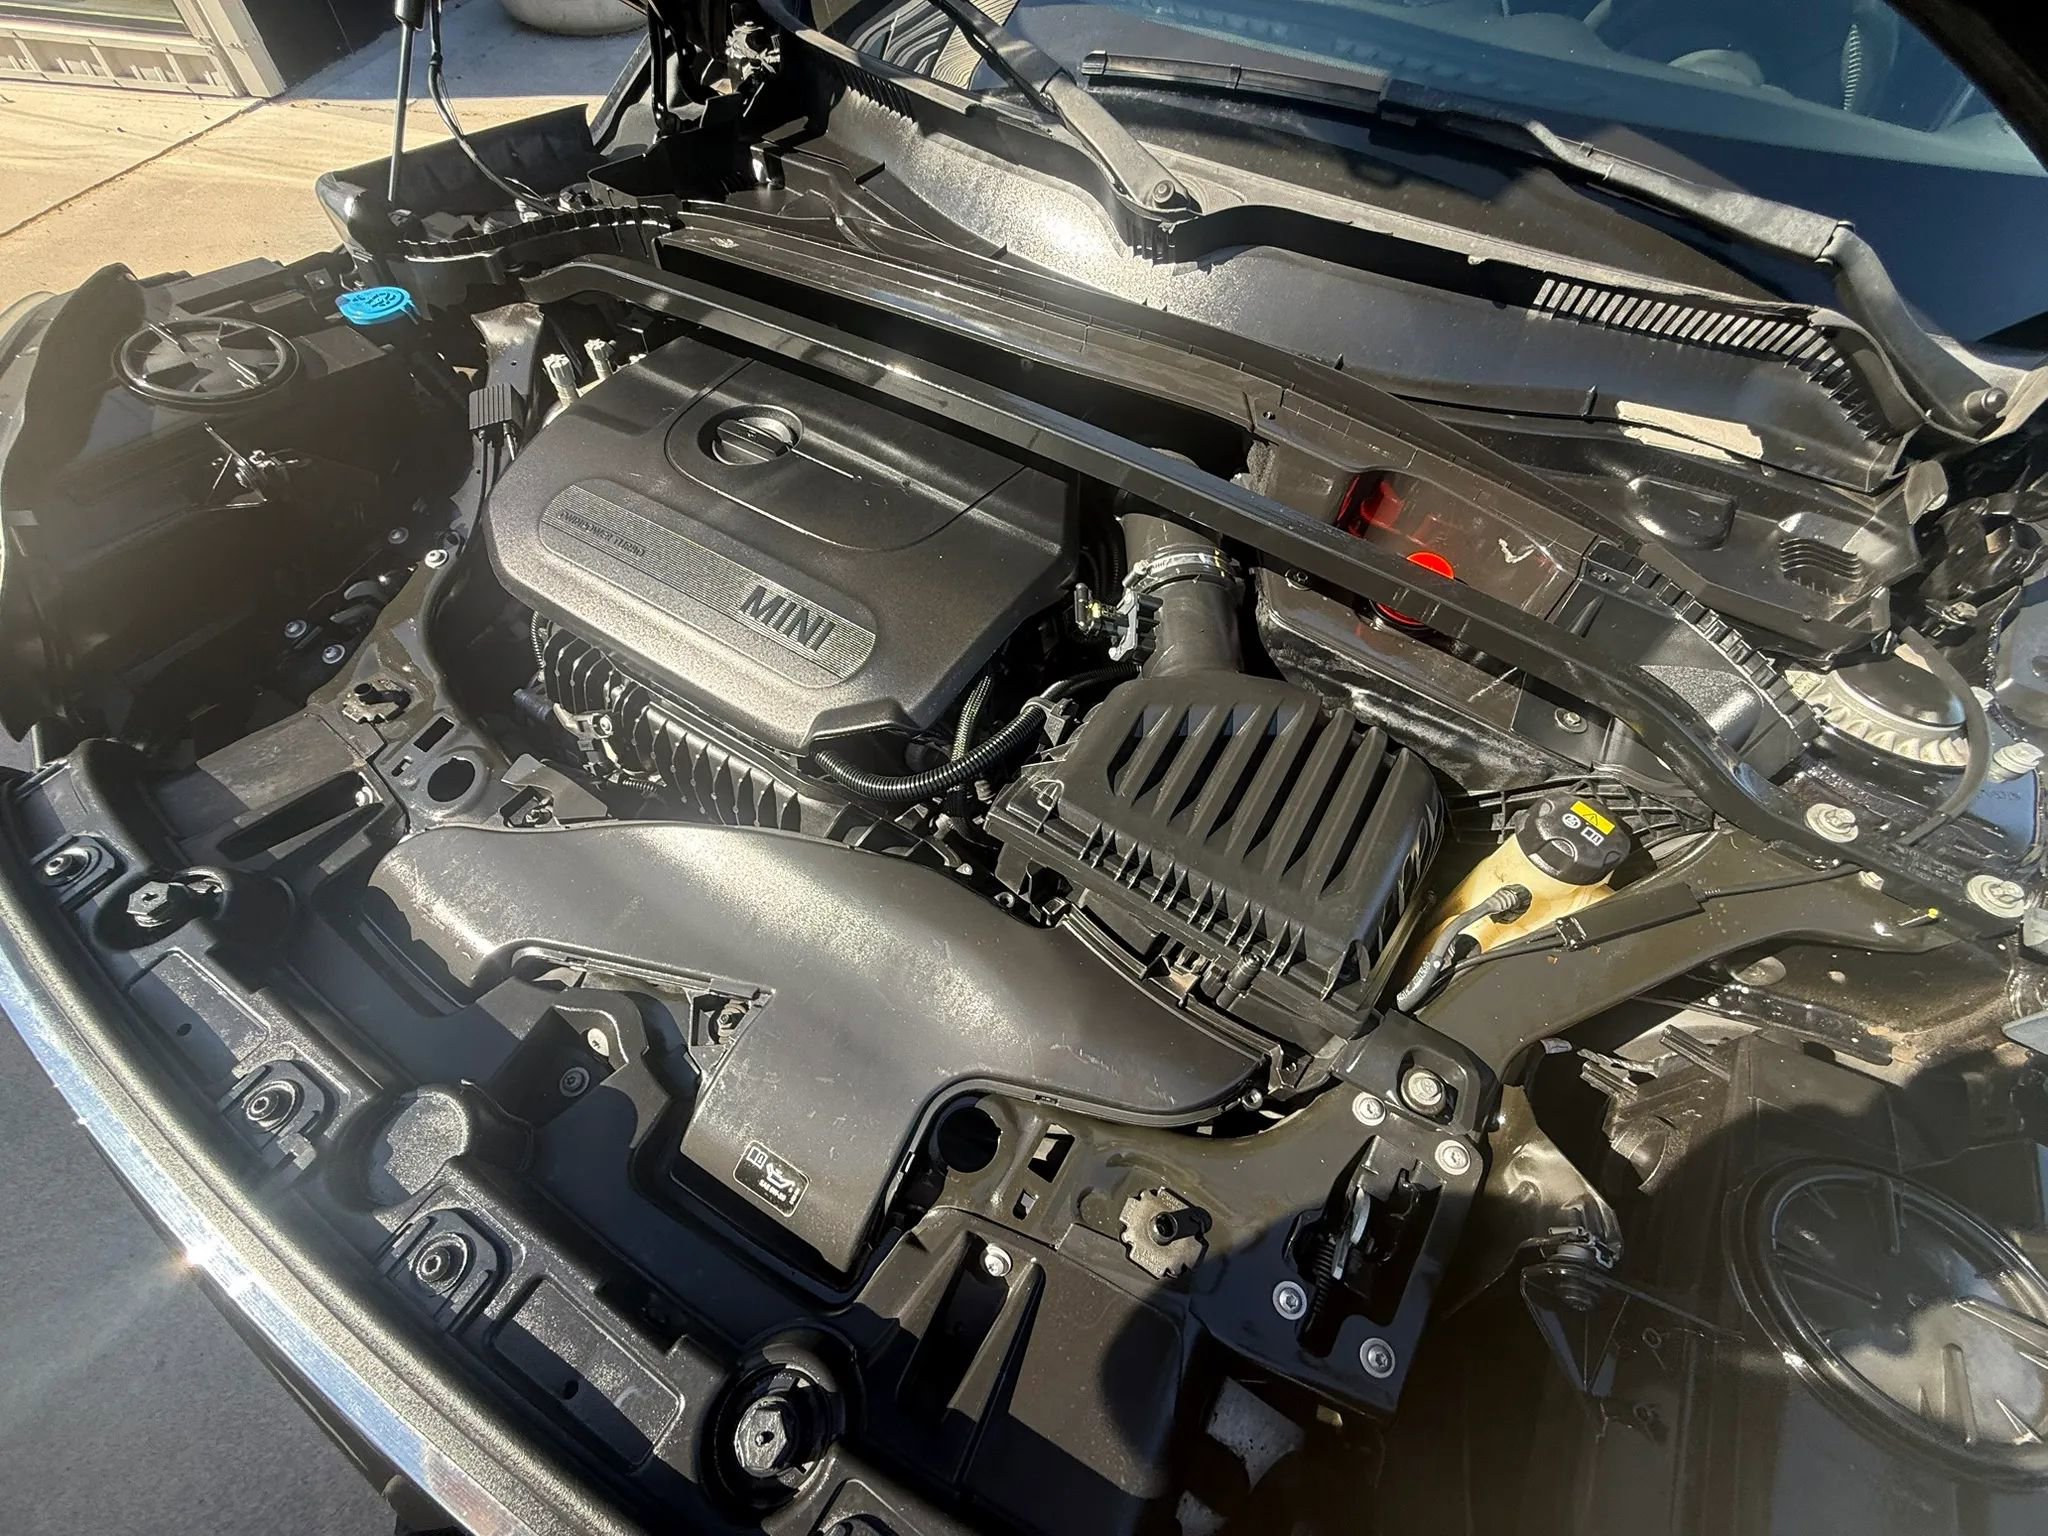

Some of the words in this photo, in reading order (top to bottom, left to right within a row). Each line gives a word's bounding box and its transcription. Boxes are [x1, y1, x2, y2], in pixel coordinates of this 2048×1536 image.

[560, 510, 613, 542] TWINPOWER
[613, 535, 646, 558] TURBO
[739, 585, 836, 653] MINI
